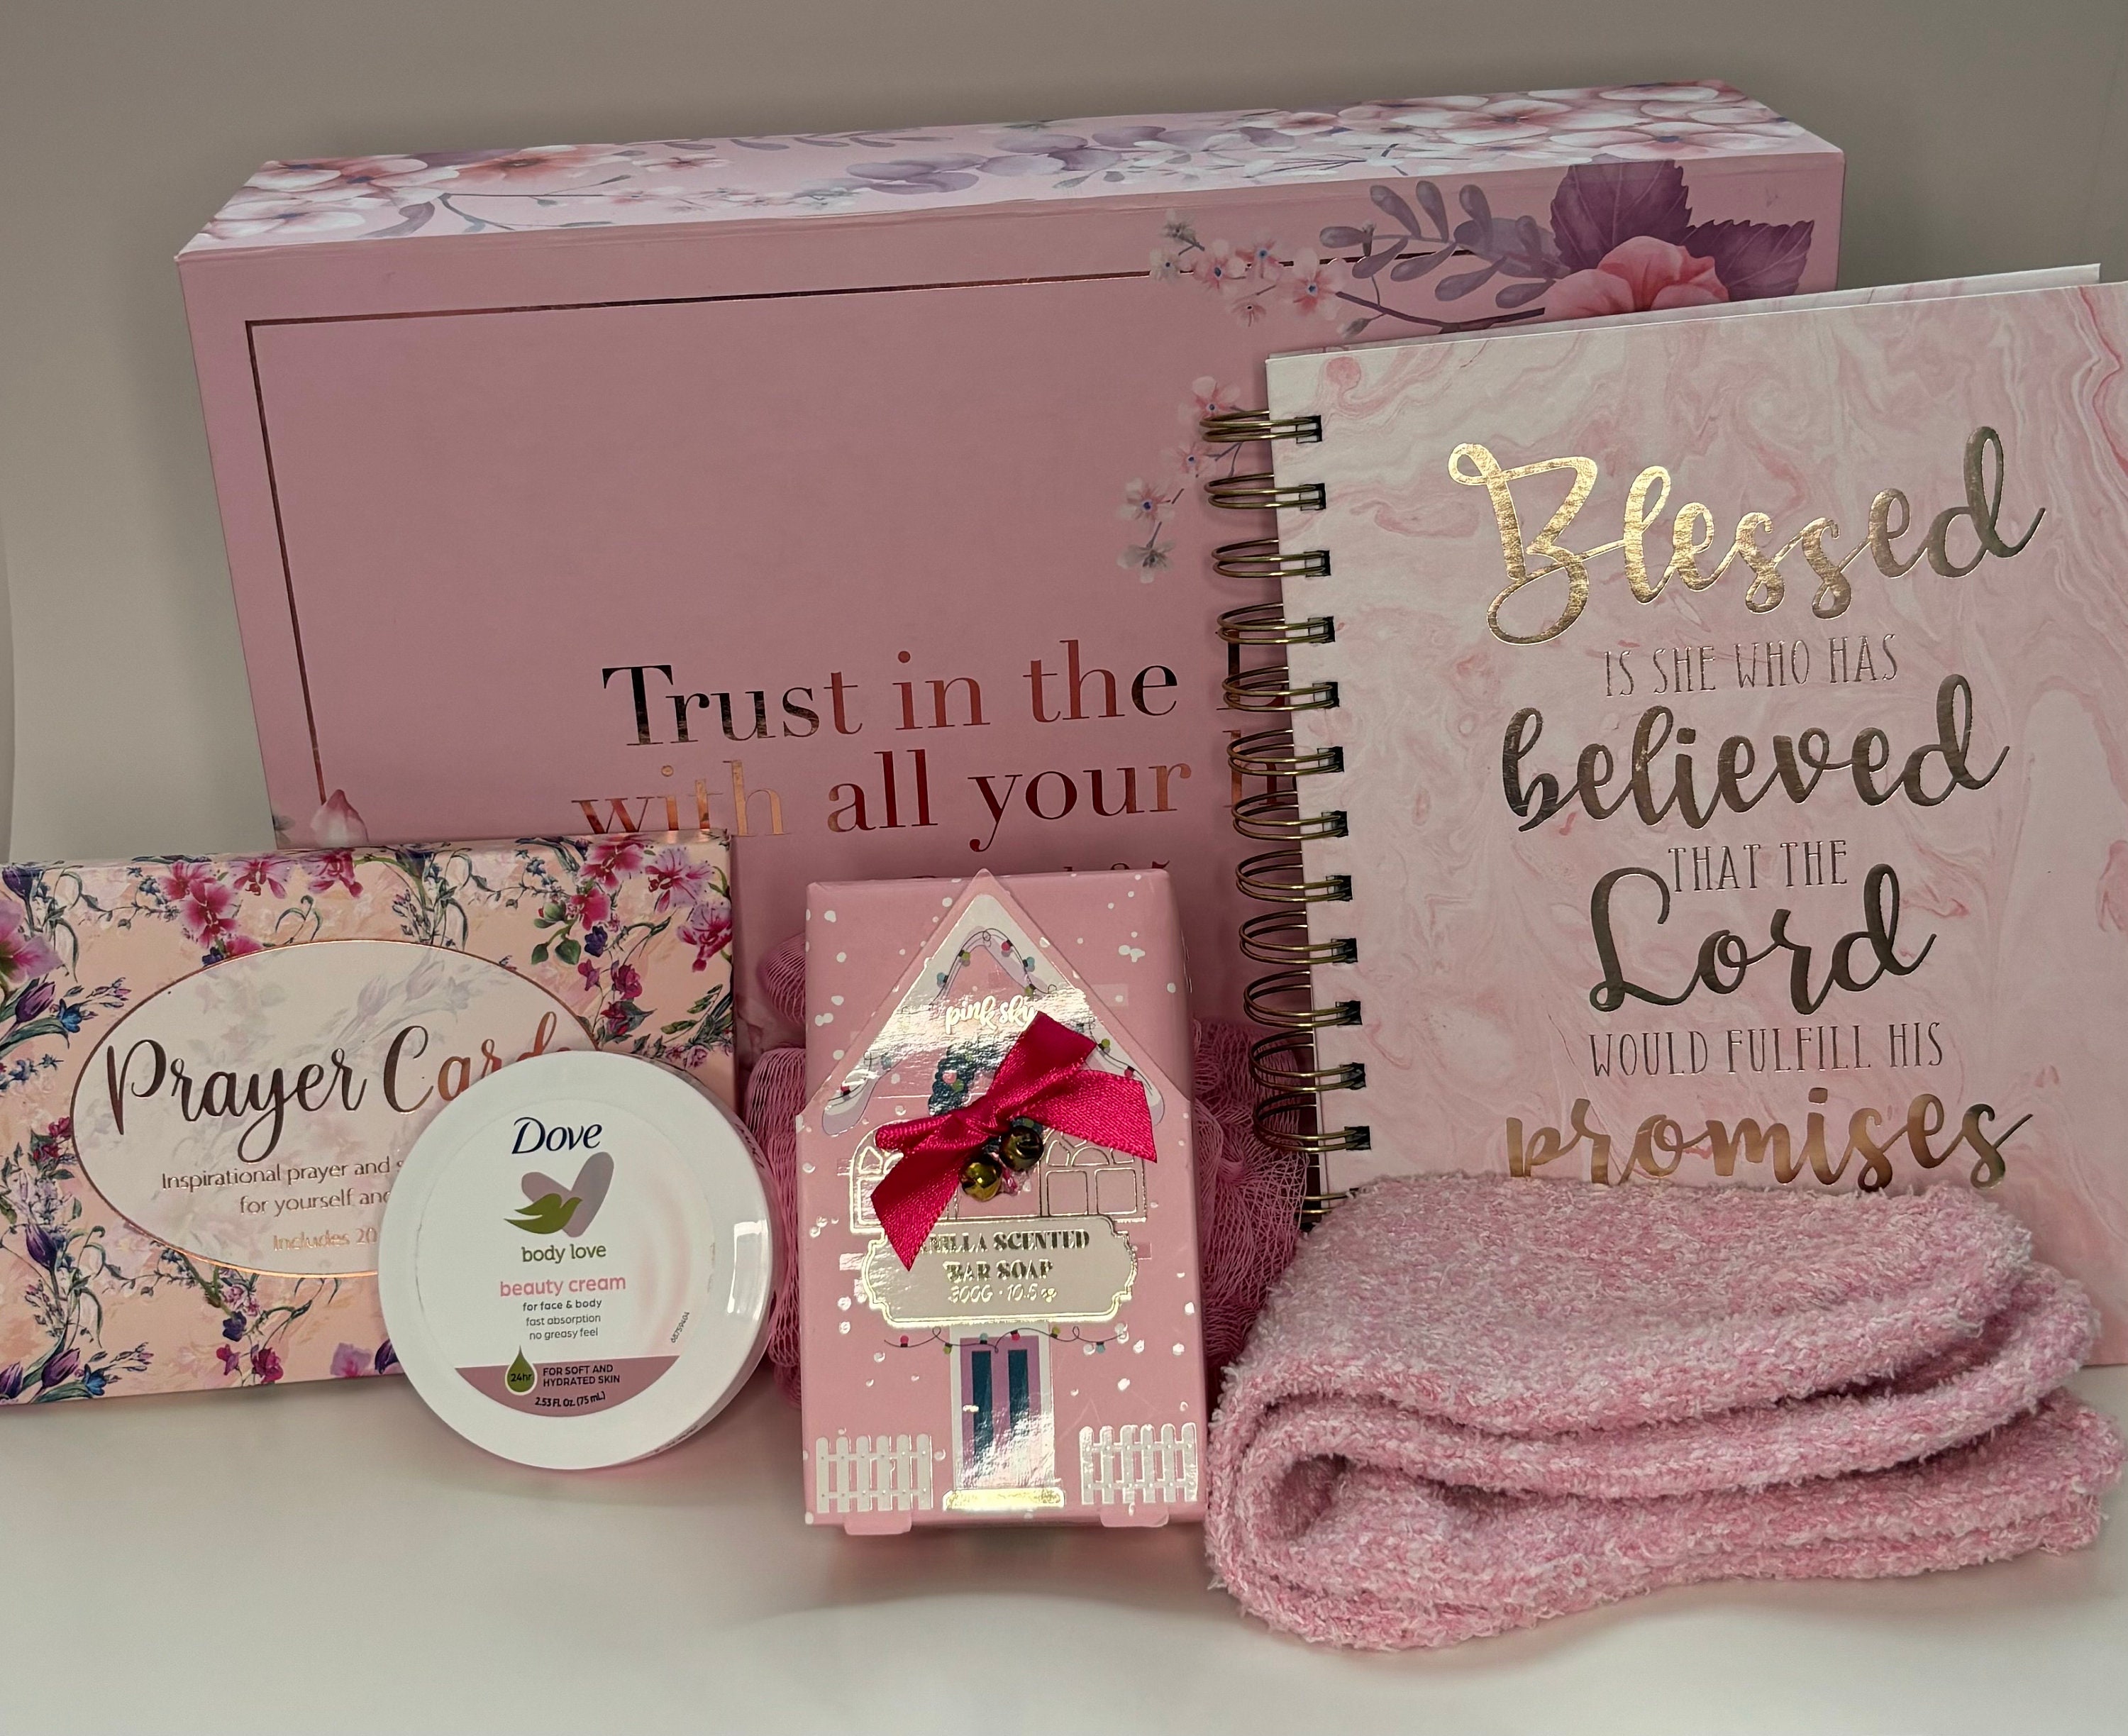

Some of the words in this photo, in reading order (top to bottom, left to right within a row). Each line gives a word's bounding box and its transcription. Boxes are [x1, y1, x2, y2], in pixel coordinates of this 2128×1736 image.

[1448, 426, 2046, 646] Blessed
[1605, 651, 1634, 697] IS
[1653, 646, 1717, 694] SHE
[1737, 639, 1810, 688] WHO
[1829, 633, 1898, 684] HAS
[602, 665, 863, 747] Trust
[894, 651, 991, 729] in
[1022, 639, 1179, 724] the
[1502, 674, 2010, 832] believed
[571, 760, 792, 837] with
[827, 748, 939, 832] all
[967, 762, 1192, 852] your
[1668, 844, 1761, 893] THAT
[1779, 840, 1847, 886] THE
[1589, 863, 1937, 1014] Lord
[1589, 1031, 1708, 1078] WOULD
[1727, 1024, 1871, 1073] FULFILL
[1888, 1022, 1944, 1068] HIS
[106, 1039, 367, 1163] Prayer
[384, 1011, 572, 1115] Card
[511, 1117, 602, 1154] Dove
[1506, 1087, 2034, 1191] promises
[162, 1163, 281, 1193] Inspirational
[287, 1163, 349, 1185] prayer
[355, 1156, 390, 1176] and
[240, 1196, 269, 1215] for
[275, 1188, 355, 1217] yourself
[273, 1230, 350, 1251] Includes
[356, 1227, 378, 1245] 20
[521, 1245, 565, 1264] body
[570, 1244, 606, 1259] love
[920, 1232, 987, 1254] NILLA
[993, 1229, 1090, 1252] SCENTED
[500, 1279, 563, 1297] beauty
[568, 1277, 626, 1292] cream
[943, 1261, 991, 1283] BAR
[996, 1259, 1053, 1281] SOAP
[523, 1303, 538, 1311] for
[541, 1301, 563, 1310] face
[575, 1298, 602, 1310] body
[526, 1317, 545, 1326] fast
[547, 1314, 601, 1325] absorption
[544, 1329, 578, 1340] greasy
[580, 1327, 598, 1337] feel
[511, 1372, 532, 1382] 24hr
[543, 1367, 563, 1376] FOR
[565, 1366, 590, 1375] SOFT
[592, 1364, 614, 1373] AND
[543, 1376, 596, 1387] HYDRATED
[598, 1375, 620, 1383] SKIN
